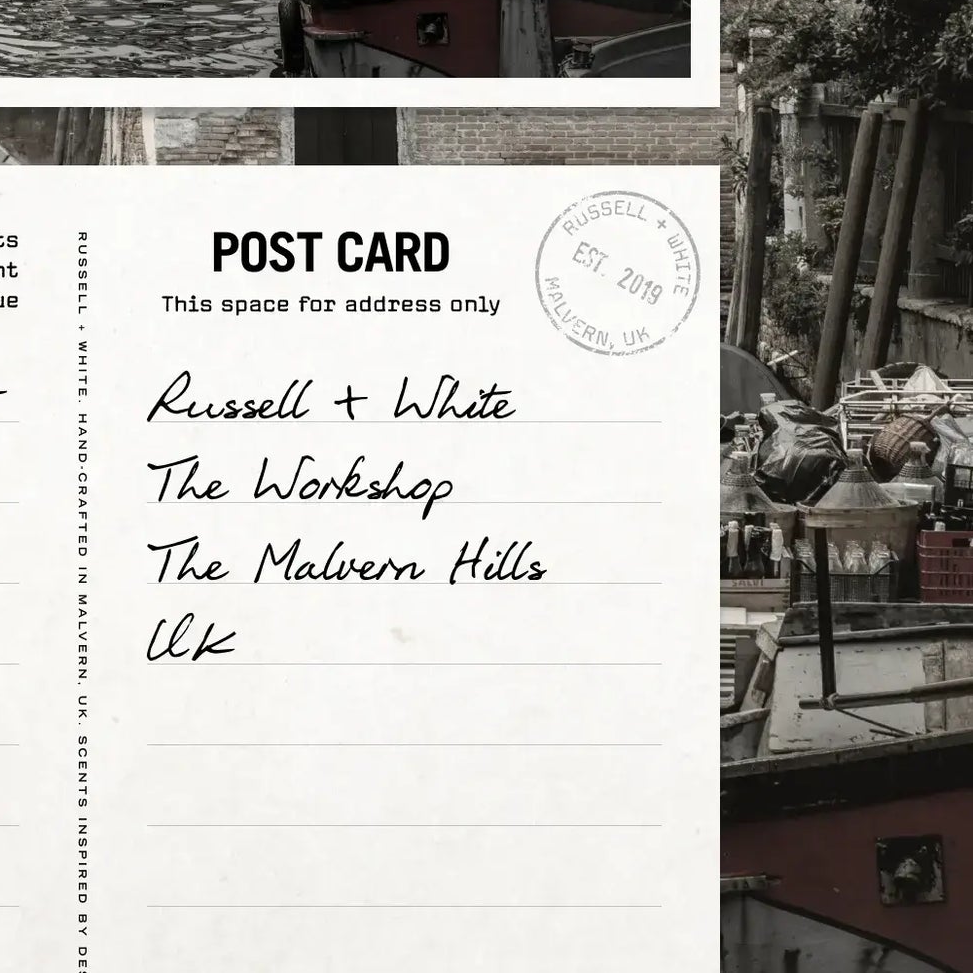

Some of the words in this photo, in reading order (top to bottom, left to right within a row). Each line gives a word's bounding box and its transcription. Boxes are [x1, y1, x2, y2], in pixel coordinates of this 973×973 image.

[78, 232, 88, 314] RUSSELL
[214, 231, 323, 273] POST
[338, 231, 450, 273] CARD
[562, 200, 646, 236] RUSSELL
[667, 233, 692, 297] WHITE
[572, 241, 609, 277] EST.
[616, 267, 663, 305] 2019
[162, 295, 211, 312] This
[222, 300, 288, 316] space
[299, 296, 335, 311] for
[346, 296, 440, 312] address
[451, 296, 500, 316] only
[545, 276, 615, 350] MALVERN,
[623, 326, 651, 346] UK
[78, 341, 88, 405] WHITE.
[147, 371, 313, 422] Russell
[334, 385, 368, 420] +
[394, 375, 516, 419] White
[147, 455, 229, 502] The
[254, 455, 453, 520] Workshop
[78, 568, 88, 583] IN
[147, 536, 229, 582] The
[254, 539, 425, 583] Malvern
[450, 537, 547, 585] Hills
[147, 613, 236, 661] UK
[78, 696, 88, 725] UK.
[78, 736, 88, 807] SCENTS
[78, 818, 88, 903] INSPIRED
[78, 914, 88, 935] BY
[78, 946, 88, 973] DE
